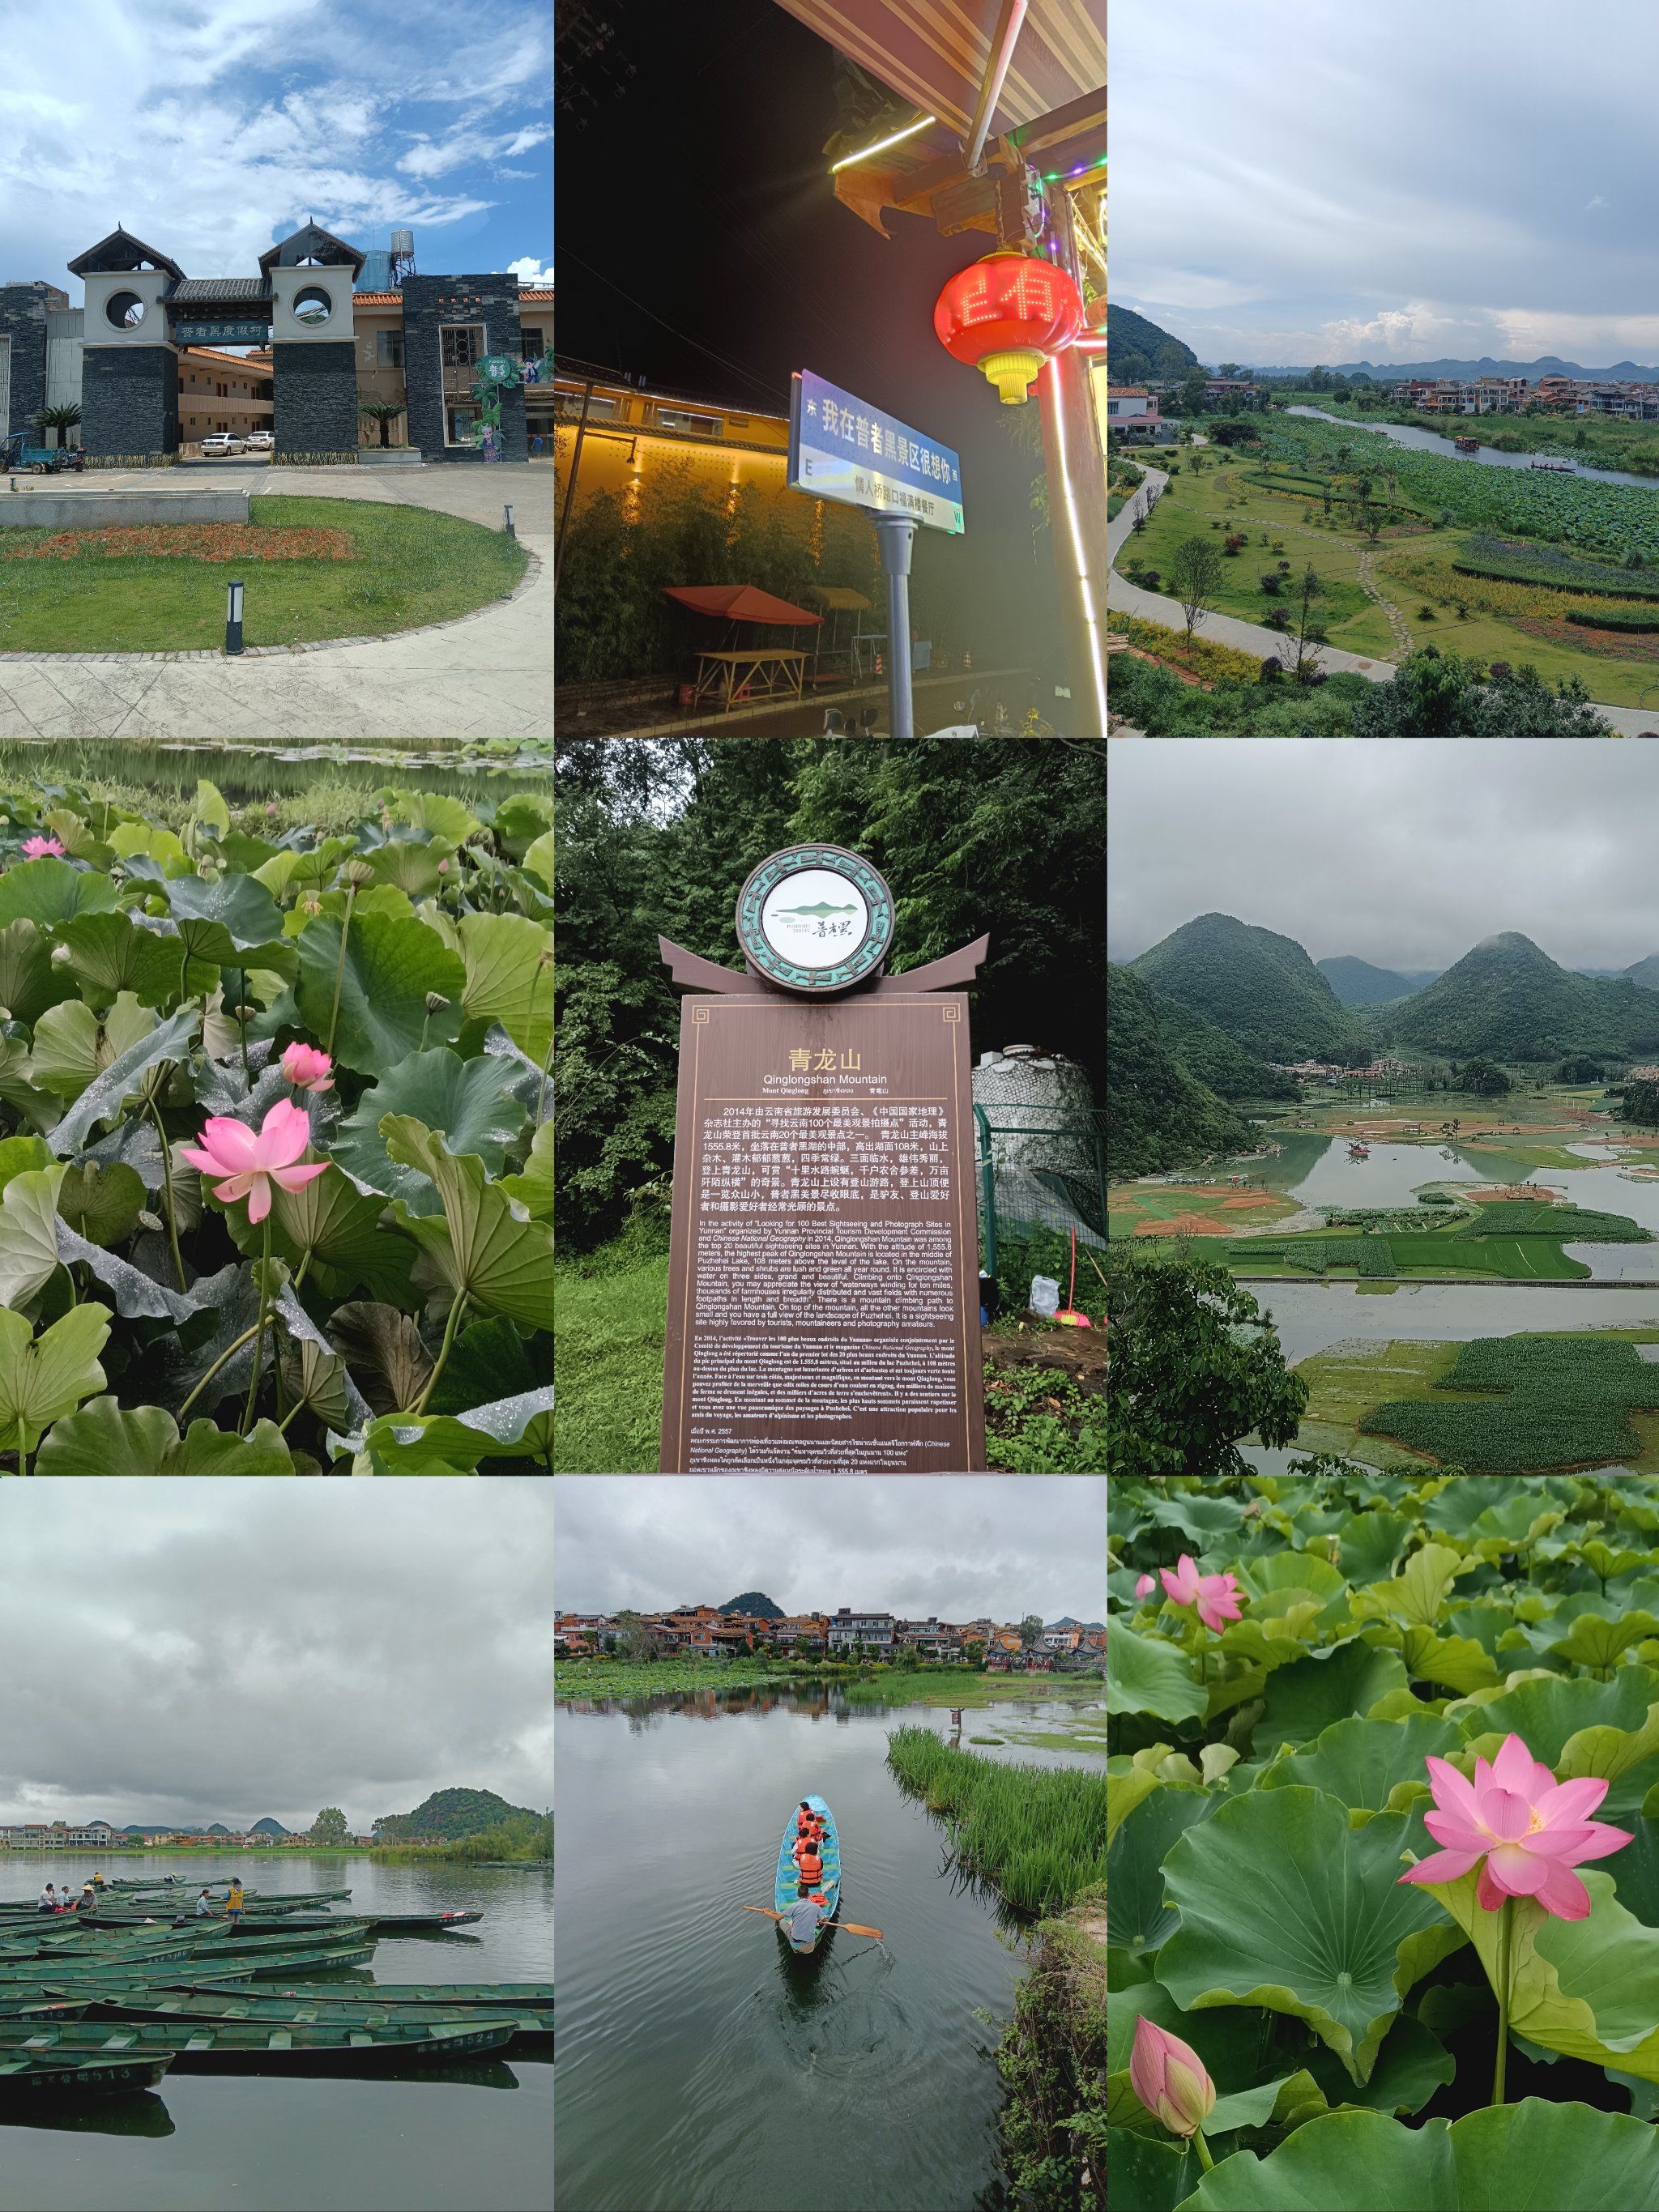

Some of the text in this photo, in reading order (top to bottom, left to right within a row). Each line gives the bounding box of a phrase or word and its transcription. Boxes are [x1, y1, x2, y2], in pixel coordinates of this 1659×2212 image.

[182, 326, 262, 337] 普者黑度假村
[807, 399, 957, 484] 东 我在普者黑景区很想你 西
[805, 458, 812, 476] E
[855, 475, 934, 516] 情人桥路口福满楼餐厅
[953, 510, 961, 523] W
[789, 1048, 861, 1072] 青龙山
[763, 1075, 887, 1086] Qinglongshan Mountain
[721, 1220, 744, 1228] activity
[830, 1221, 868, 1229] Sightseeing
[885, 1221, 923, 1229] Photograph
[729, 1227, 761, 1235] organized
[763, 1227, 772, 1235] by
[864, 1228, 908, 1236] Development
[770, 1235, 807, 1243] Geography
[834, 1235, 881, 1243] Qinglongshan
[711, 1242, 722, 1251] top
[765, 1242, 803, 1251] sightseeing
[737, 1250, 761, 1258] highest
[761, 1250, 778, 1258] peak
[788, 1250, 834, 1259] Qinglongshan
[695, 1303, 742, 1311] Qinglongshan
[791, 1303, 802, 1312] top
[816, 1312, 851, 1320] landscape
[915, 1313, 954, 1321] sightseeing
[709, 1319, 729, 1327] highly
[757, 1319, 766, 1328] by
[857, 1320, 900, 1328] photography
